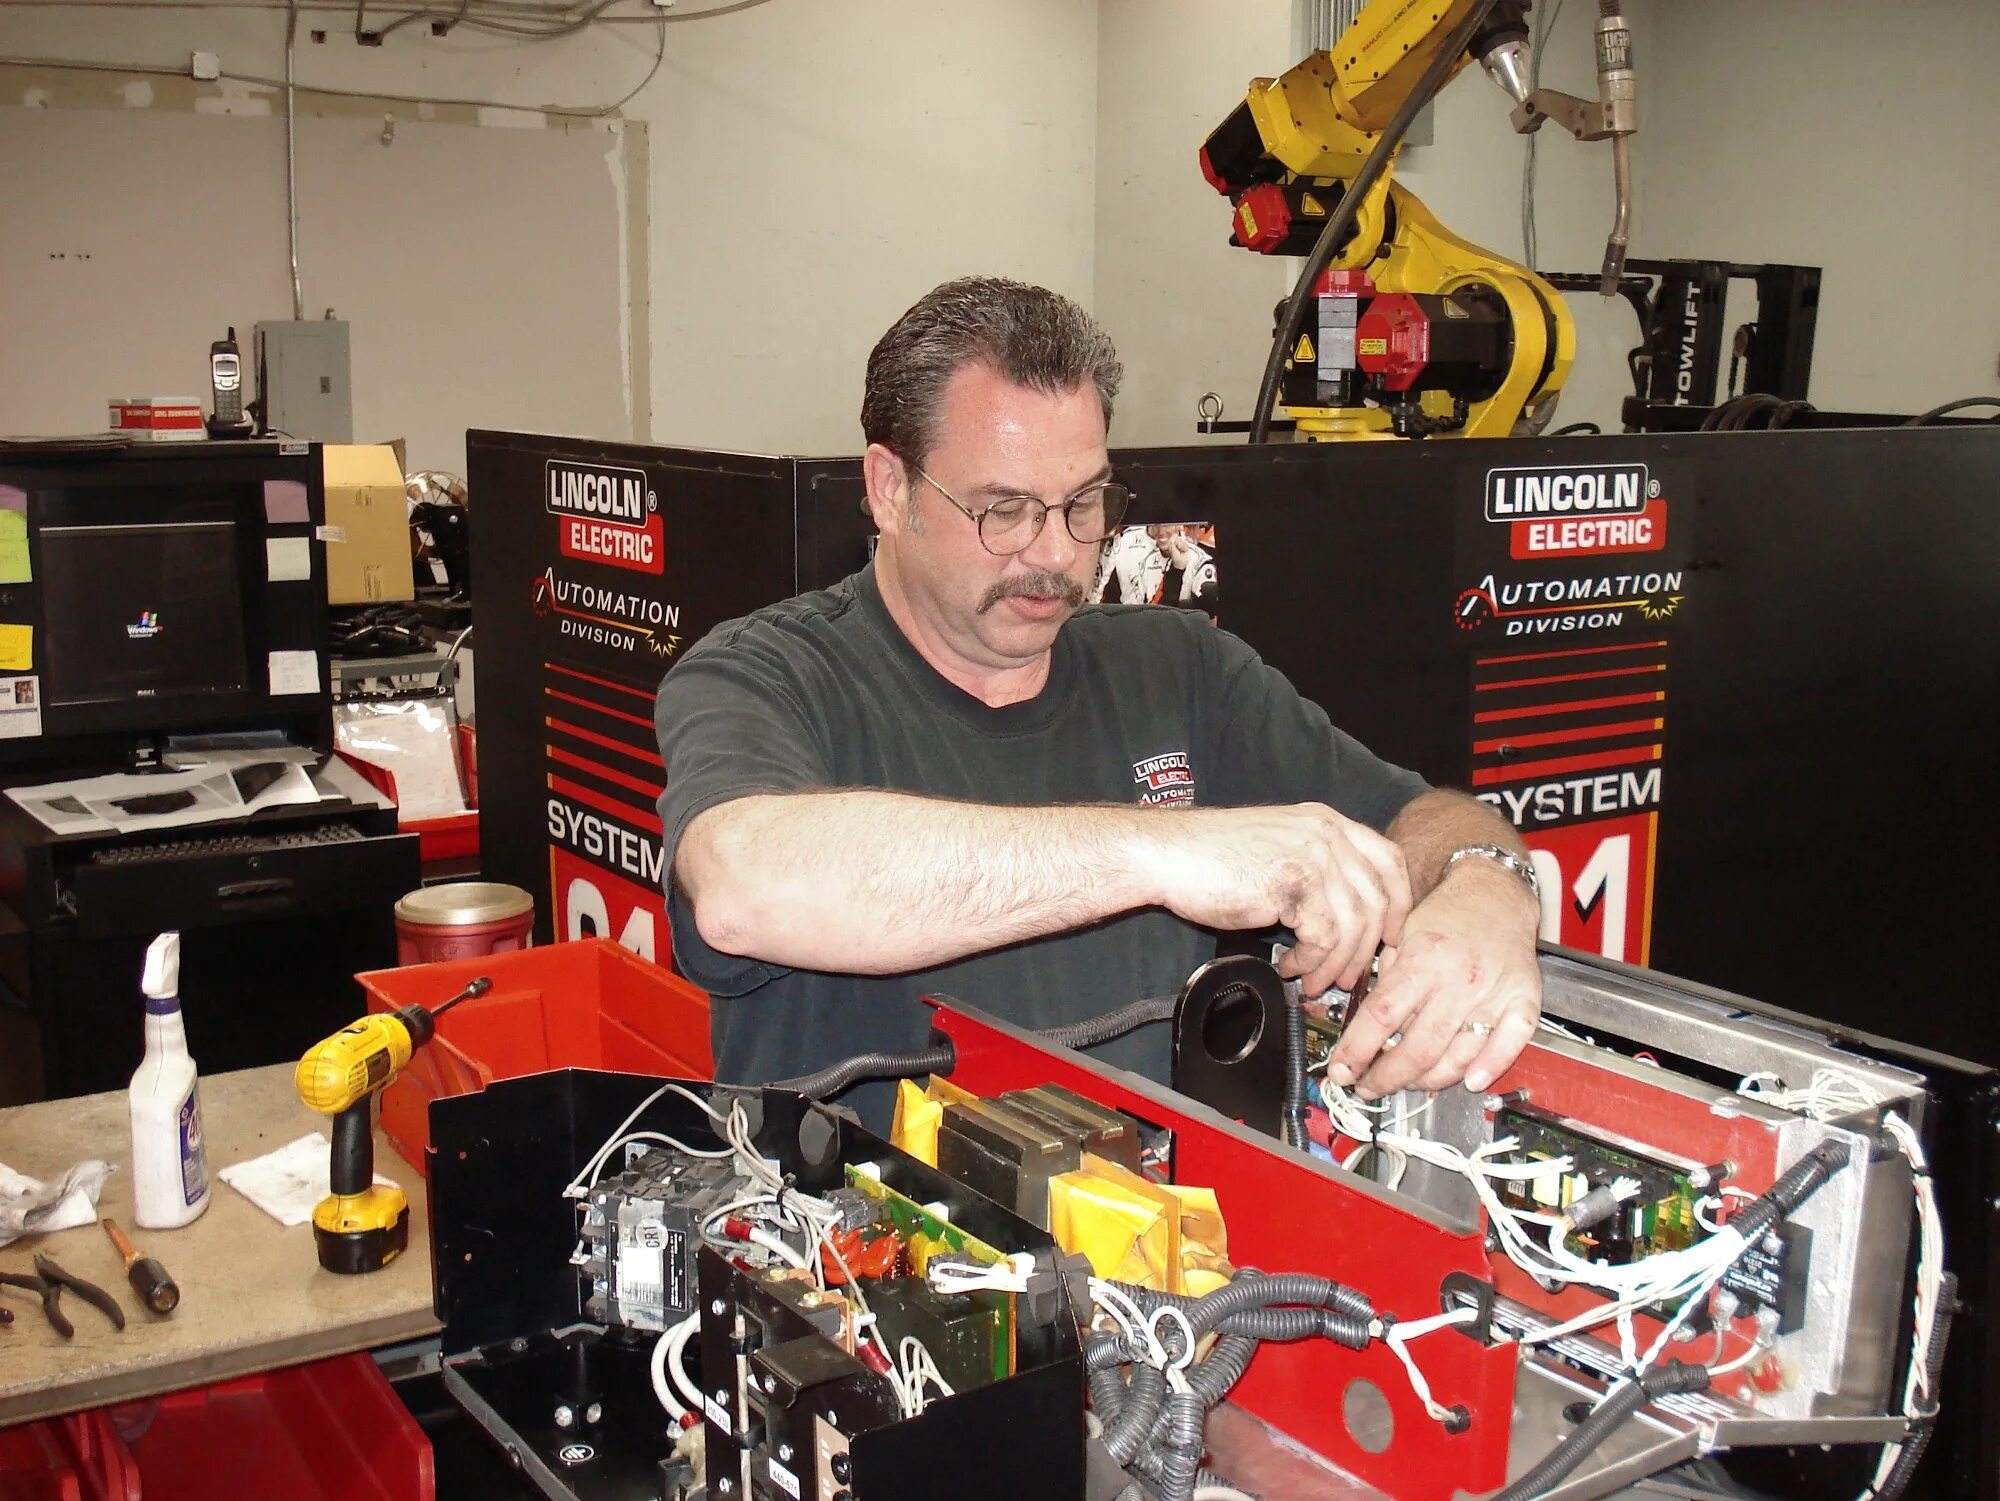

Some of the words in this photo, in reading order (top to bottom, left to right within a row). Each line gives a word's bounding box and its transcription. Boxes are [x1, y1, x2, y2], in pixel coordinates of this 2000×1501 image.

[1674, 281, 1700, 406] TOWLIFT
[551, 470, 641, 519] LINCOLN
[1495, 472, 1639, 514] LINCOLN
[571, 523, 653, 564] ELECTRIC
[1528, 518, 1652, 551] ELECTRIC
[536, 566, 680, 628] AUTOMATION
[1461, 571, 1683, 616] AUTOMATION
[561, 619, 635, 651] DIVISION
[1506, 612, 1623, 636] DIVISION
[548, 799, 664, 883] SYSTEM
[642, 1226, 661, 1248] CR1
